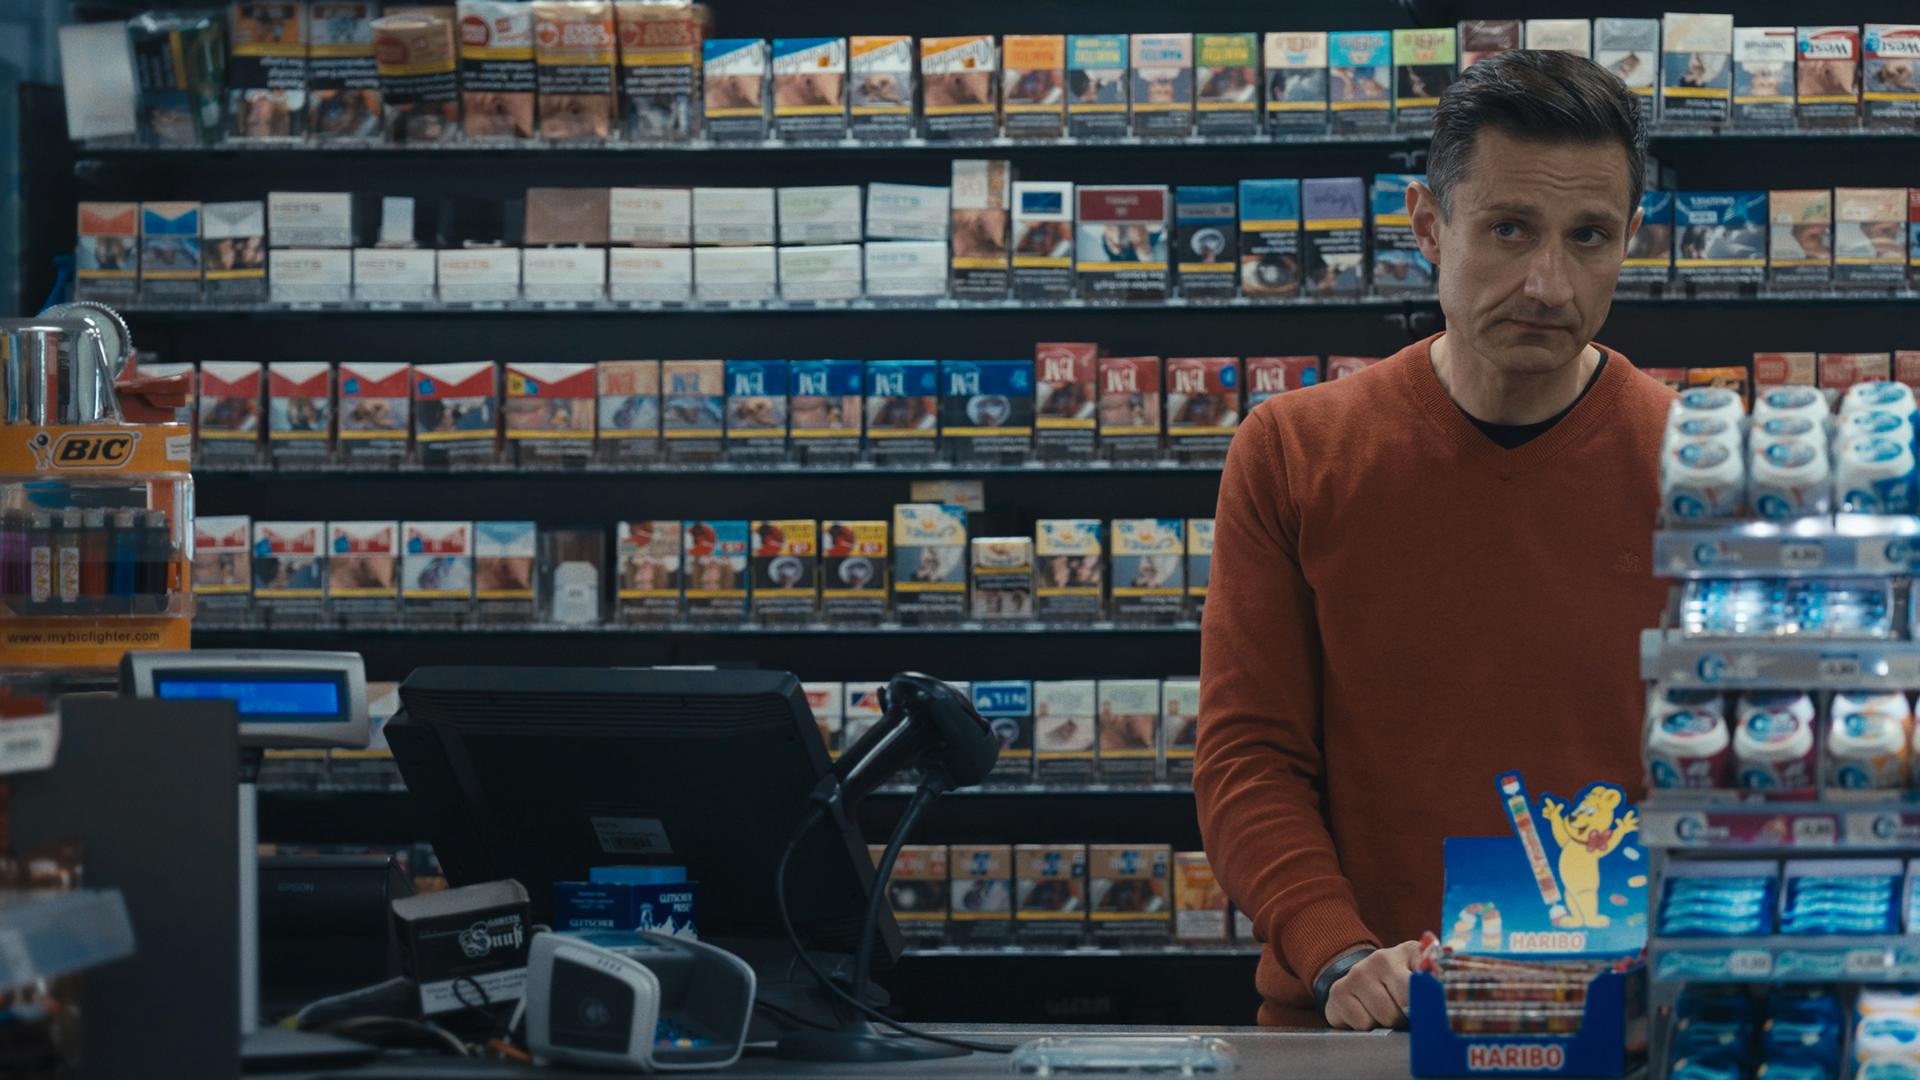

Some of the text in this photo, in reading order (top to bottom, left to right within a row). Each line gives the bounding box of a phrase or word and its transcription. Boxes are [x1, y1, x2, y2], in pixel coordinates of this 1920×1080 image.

[1810, 44, 1849, 56] West
[7, 631, 160, 646] www.mybiclighter.com
[276, 882, 315, 893] EPSON
[1510, 933, 1585, 950] HARIBO
[1467, 1044, 1566, 1070] HARIBO
